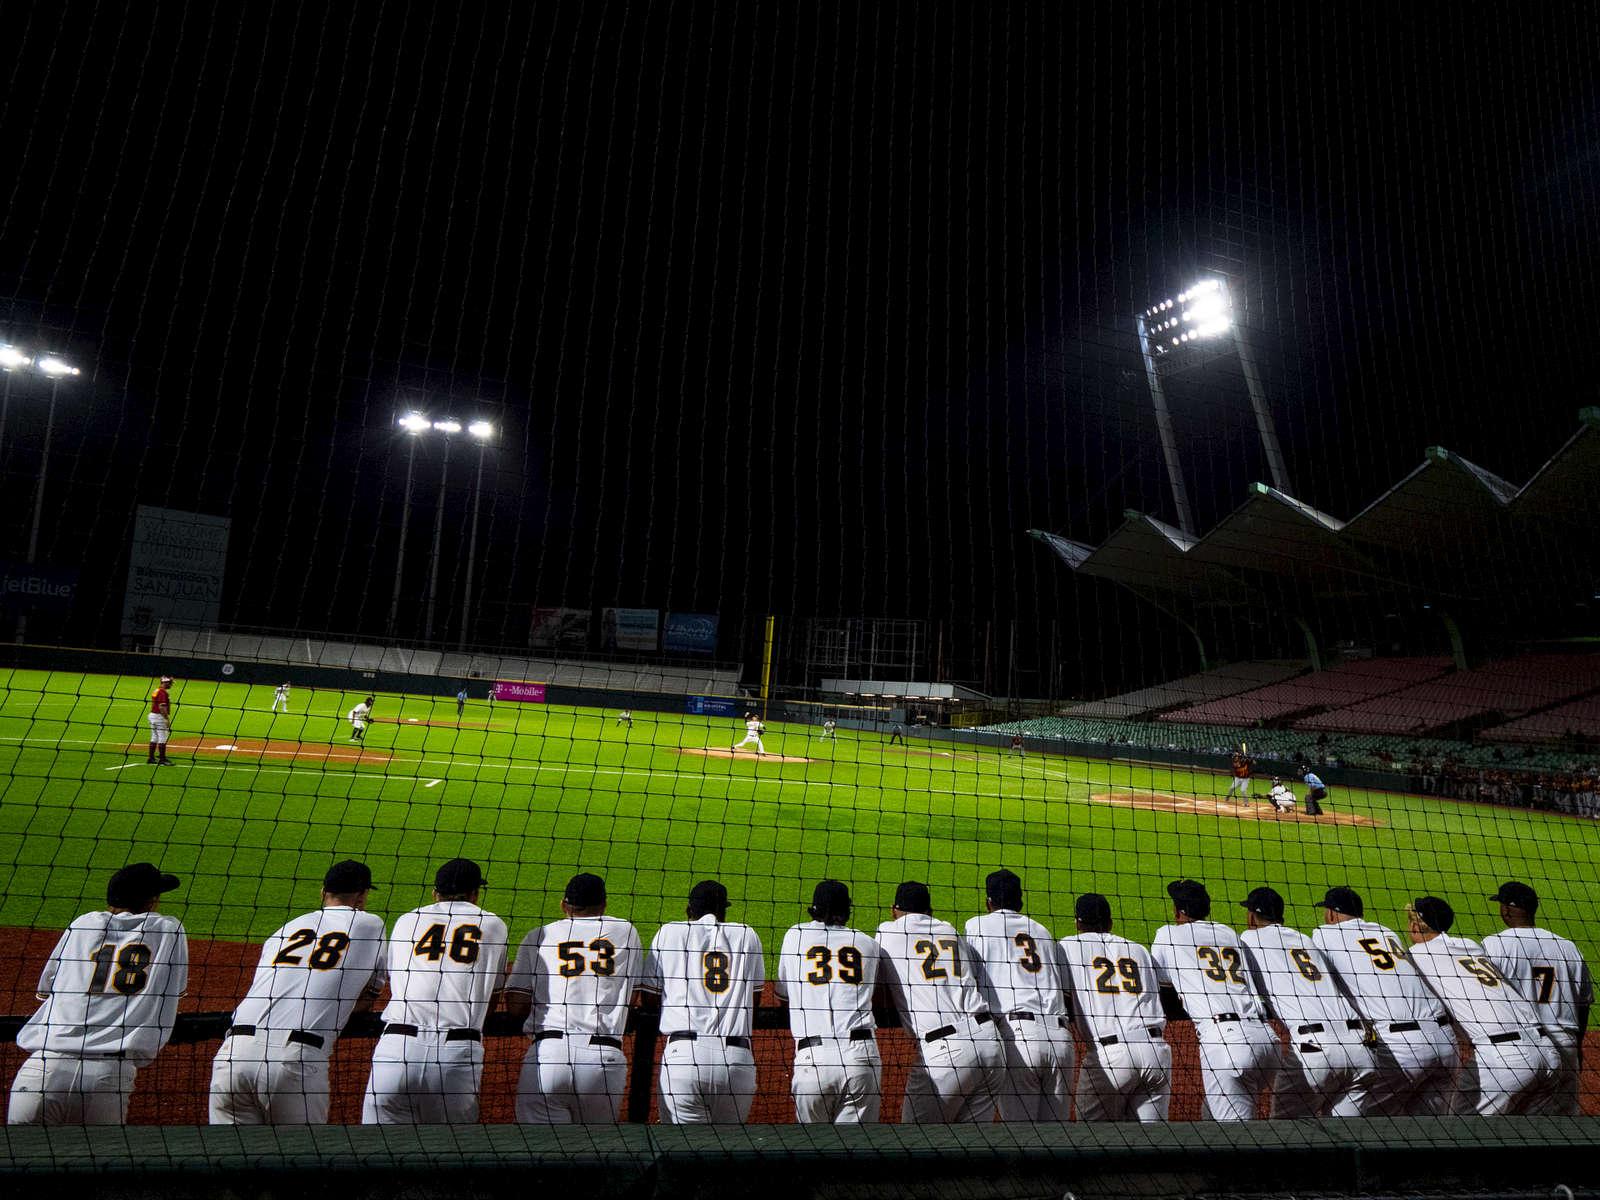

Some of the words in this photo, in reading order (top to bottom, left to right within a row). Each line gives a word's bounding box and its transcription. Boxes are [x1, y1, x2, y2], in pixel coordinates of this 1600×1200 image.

[1, 573, 71, 597] jetBlue
[134, 578, 170, 595] SAN
[174, 581, 219, 598] JUAN
[272, 928, 350, 970] 28
[414, 923, 482, 964] 46
[557, 937, 616, 978] 53
[915, 938, 960, 980] 27
[1014, 932, 1042, 973] 3
[88, 943, 152, 995] 18
[703, 951, 730, 994] 8
[806, 945, 863, 986] 39
[1092, 956, 1143, 995] 29
[1197, 945, 1247, 985] 32
[1290, 948, 1322, 982] 6
[1531, 966, 1556, 1004] 7
